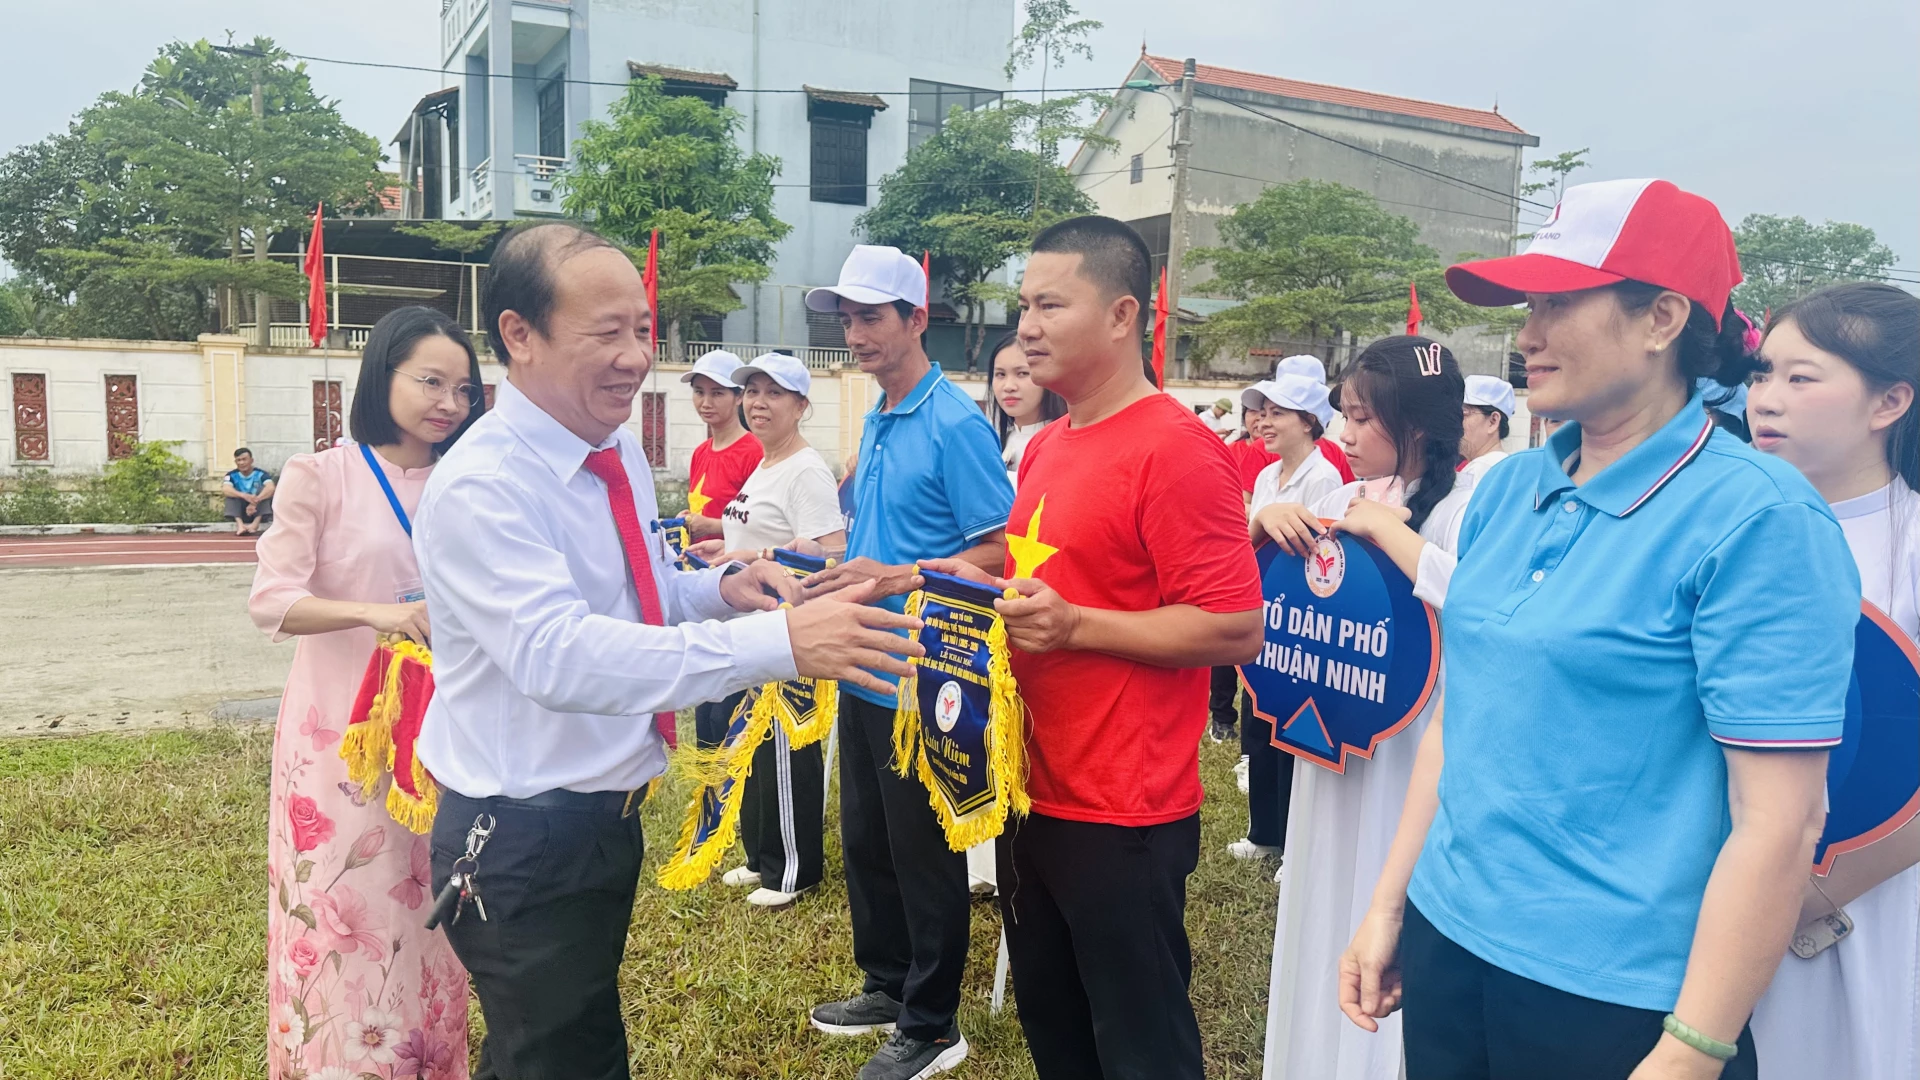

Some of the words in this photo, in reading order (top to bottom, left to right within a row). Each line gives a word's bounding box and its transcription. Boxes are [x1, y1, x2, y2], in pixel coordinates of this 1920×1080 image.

[1263, 593, 1285, 630] TỔ
[1288, 604, 1333, 644] DÂN
[1338, 617, 1391, 658] PHỐ
[1325, 658, 1387, 704] NINH
